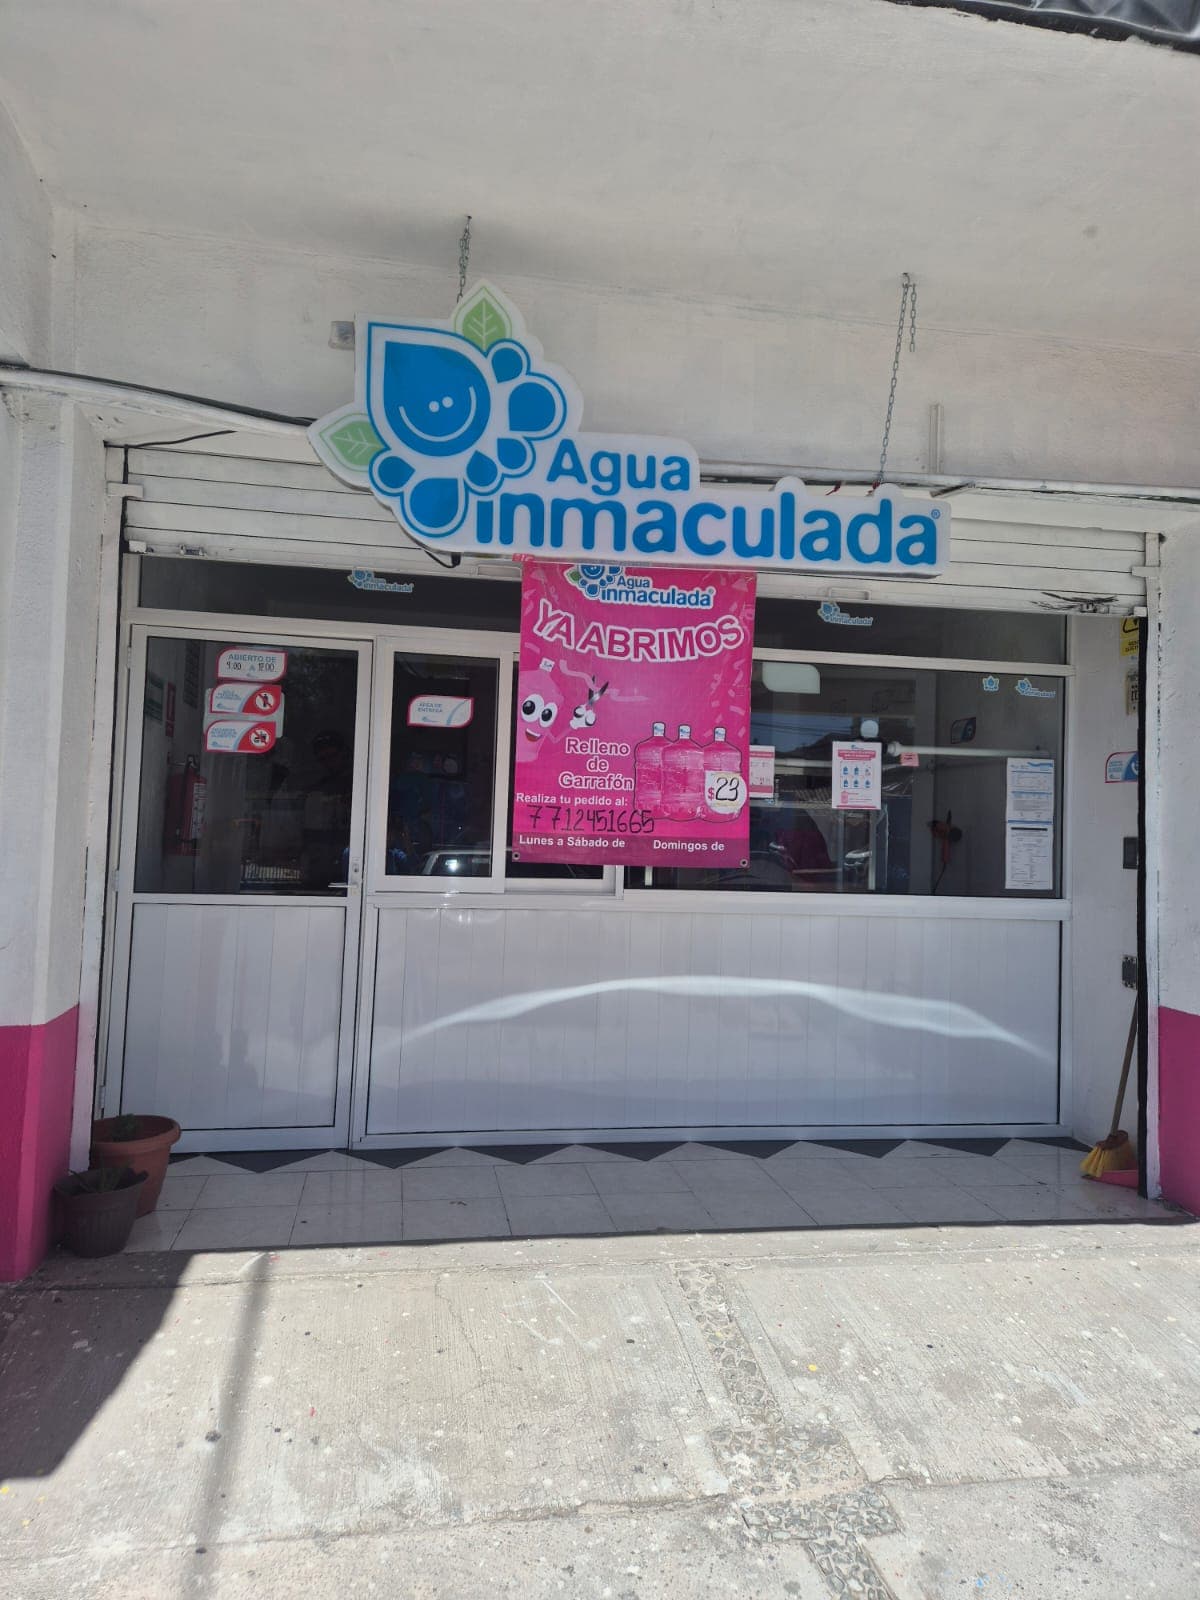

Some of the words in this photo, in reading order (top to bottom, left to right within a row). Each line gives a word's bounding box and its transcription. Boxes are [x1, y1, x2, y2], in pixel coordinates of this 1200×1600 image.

[548, 438, 691, 496] Agua
[475, 491, 937, 566] inmaculada
[617, 576, 650, 590] Agua
[601, 588, 711, 607] inmaculada
[534, 599, 575, 648] YA
[576, 614, 744, 662] ABRIMOS
[565, 737, 630, 756] Relleno
[586, 756, 609, 773] de
[559, 772, 633, 791] Garrafón
[707, 776, 740, 802] $23
[516, 792, 556, 804] Realiza
[560, 795, 571, 805] tu
[574, 795, 610, 808] pedido
[613, 796, 628, 806] al:
[519, 835, 553, 848] Lunes
[557, 839, 564, 847] a
[567, 836, 610, 849] Sábado
[612, 838, 625, 849] de
[653, 839, 708, 853] Domingos
[711, 842, 725, 852] de
